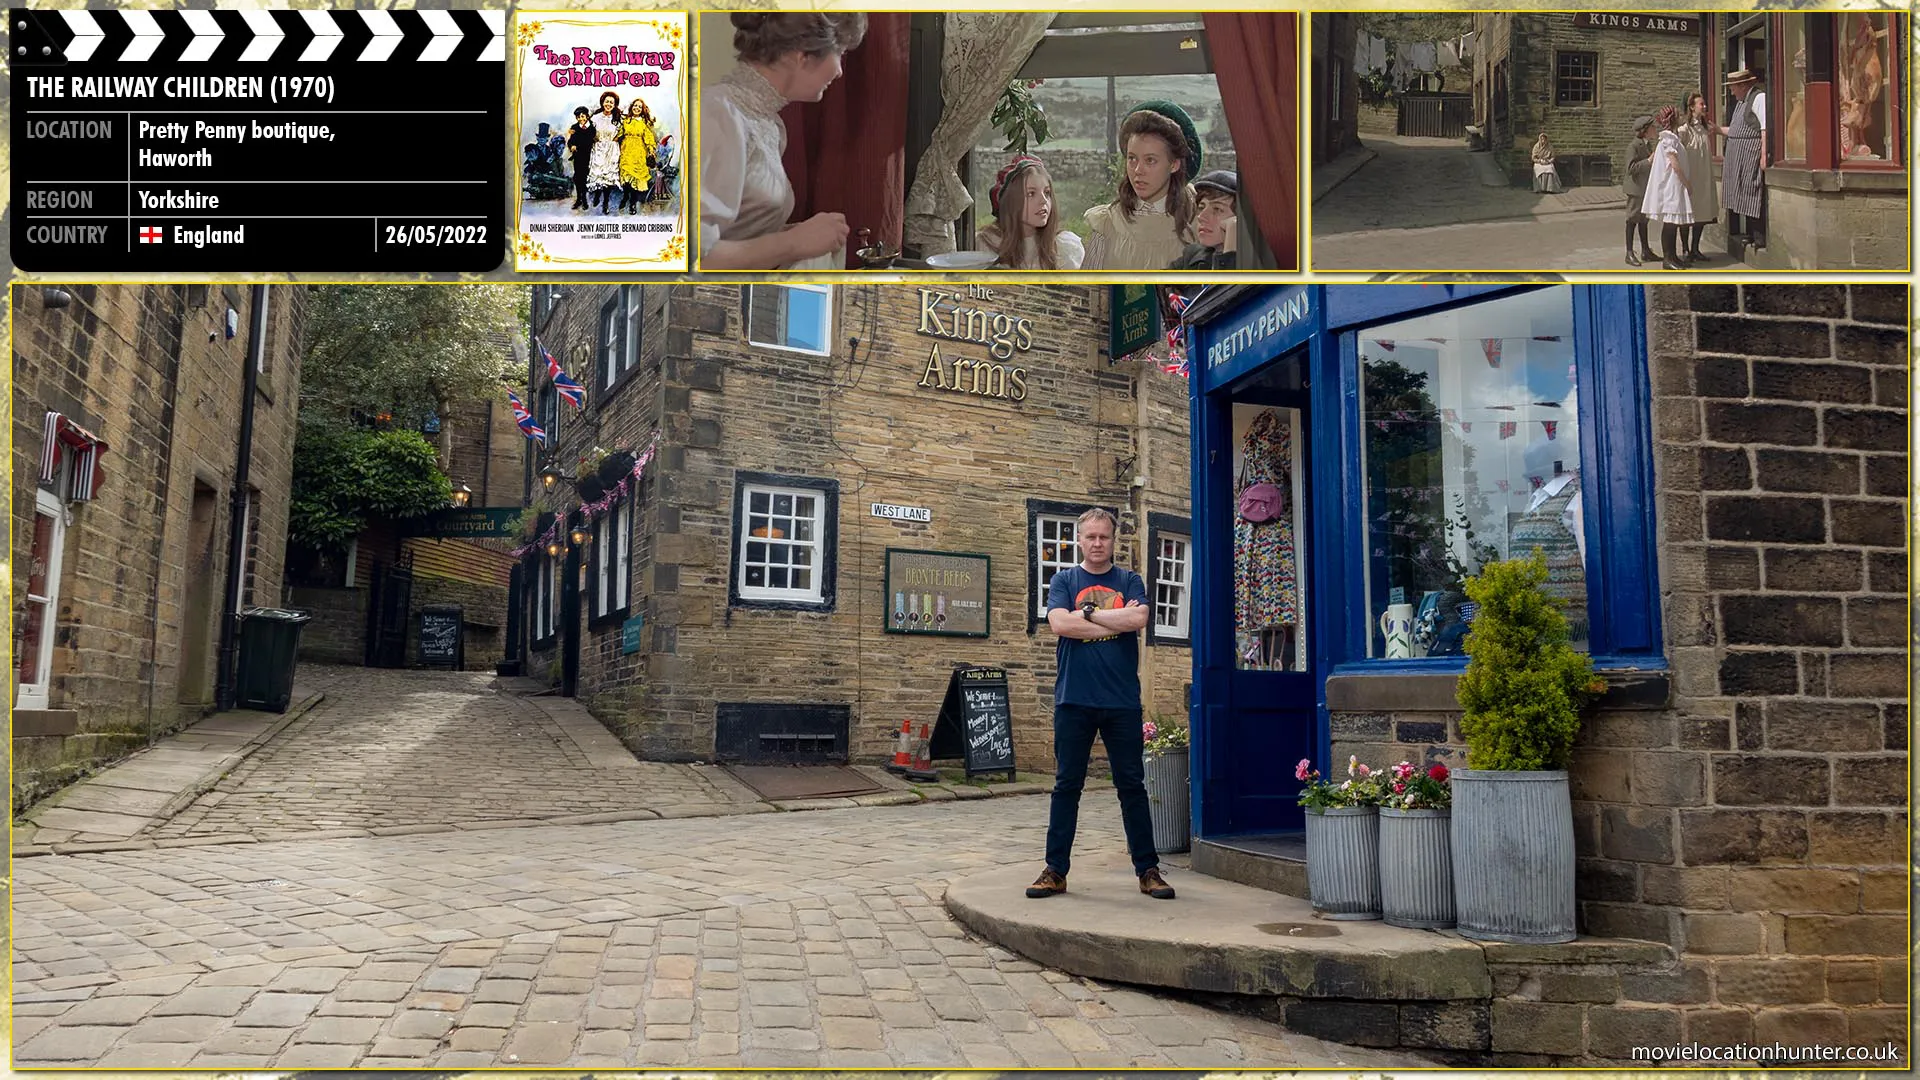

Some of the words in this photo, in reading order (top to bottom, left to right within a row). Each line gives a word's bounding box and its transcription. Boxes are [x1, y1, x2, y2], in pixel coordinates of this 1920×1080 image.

[1589, 13, 1640, 28] KINGS
[1646, 18, 1688, 31] ARMS
[533, 45, 570, 66] The
[572, 45, 675, 70] Railway
[549, 67, 660, 87] Children
[530, 223, 547, 233] DINAH
[548, 223, 574, 233] SHERIDAN
[577, 223, 595, 233] JENNY
[595, 223, 620, 233] AGUTTER
[622, 223, 646, 233] BERNARD
[648, 223, 673, 233] CRIBBINS
[968, 283, 994, 301] The
[916, 288, 1034, 359] Kings
[1121, 308, 1149, 330] Kings
[1122, 324, 1148, 344] Arms
[917, 342, 1029, 401] Arms
[874, 504, 900, 517] WEST
[903, 507, 928, 520] LANE
[436, 519, 495, 533] Courtyard
[966, 671, 984, 680] Kings
[985, 670, 1002, 678] Arms
